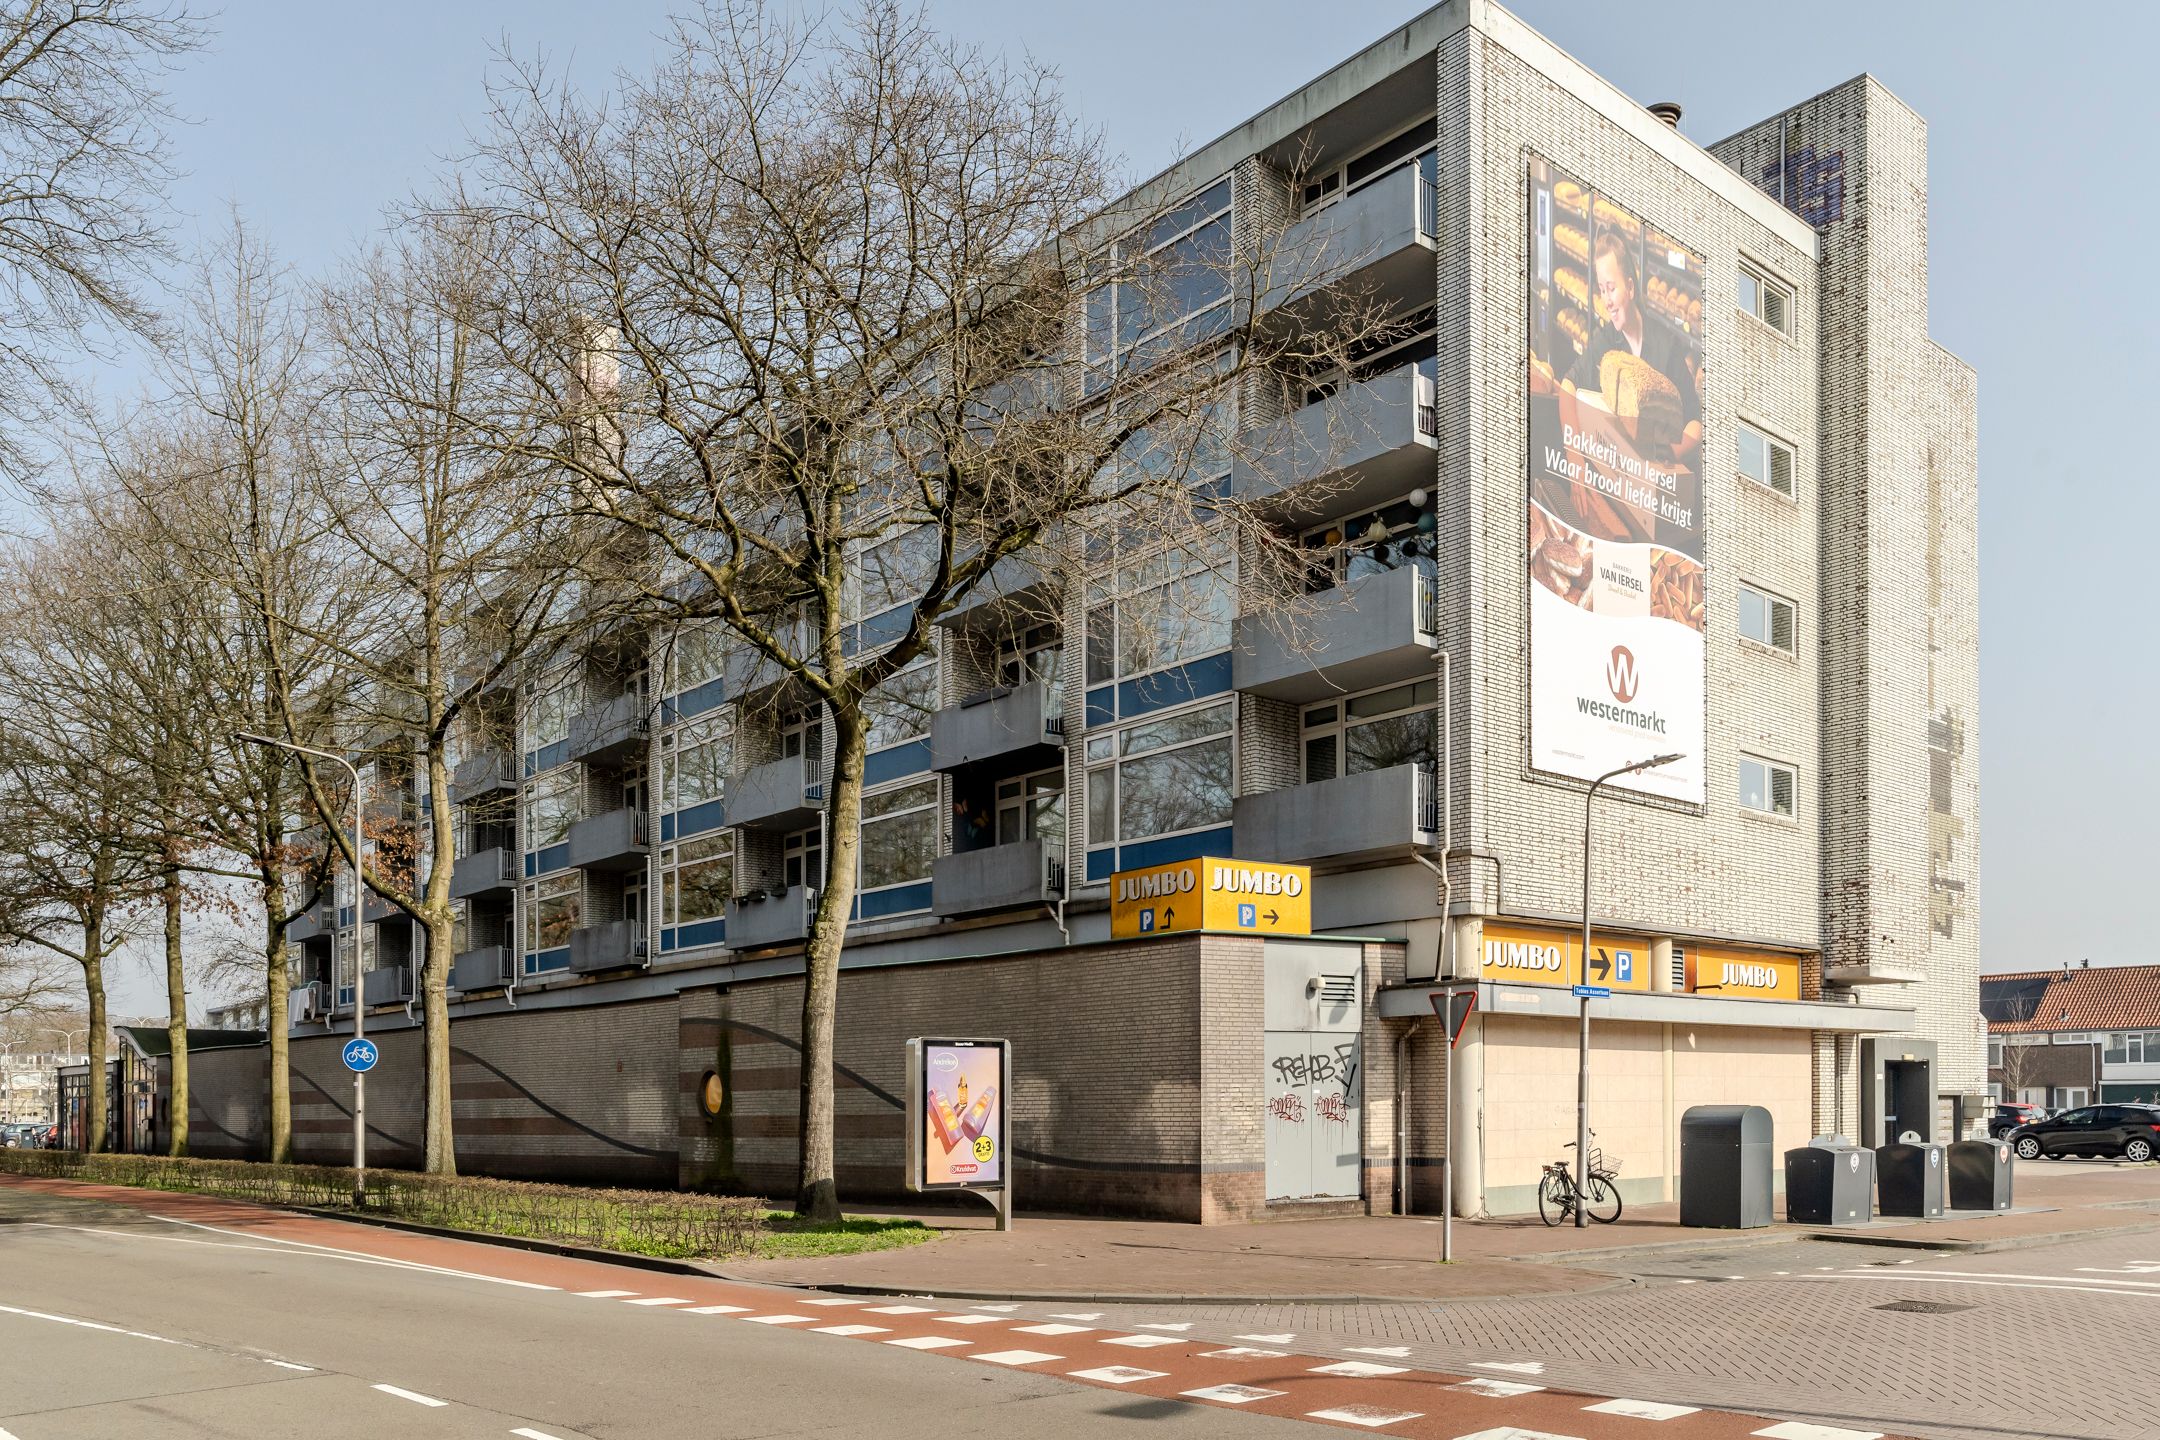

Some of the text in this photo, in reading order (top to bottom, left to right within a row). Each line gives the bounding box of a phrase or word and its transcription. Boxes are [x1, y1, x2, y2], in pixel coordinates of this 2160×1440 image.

[1563, 424, 1617, 470] Bakkerij
[1619, 455, 1642, 476] van
[1645, 460, 1676, 492] Iersel
[1544, 446, 1692, 527] Waar brood liefde krijgt
[1600, 566, 1644, 593] VAN IERSEL
[1577, 696, 1666, 734] westermarkt
[1118, 868, 1196, 904] JUMBO
[1210, 866, 1303, 897] JUMBO
[1143, 911, 1152, 930] P
[1242, 906, 1253, 925] P
[1482, 940, 1561, 972] JUMBO
[1618, 954, 1630, 979] P
[1720, 962, 1779, 989] JUMBO
[975, 1140, 992, 1153] 2+3
